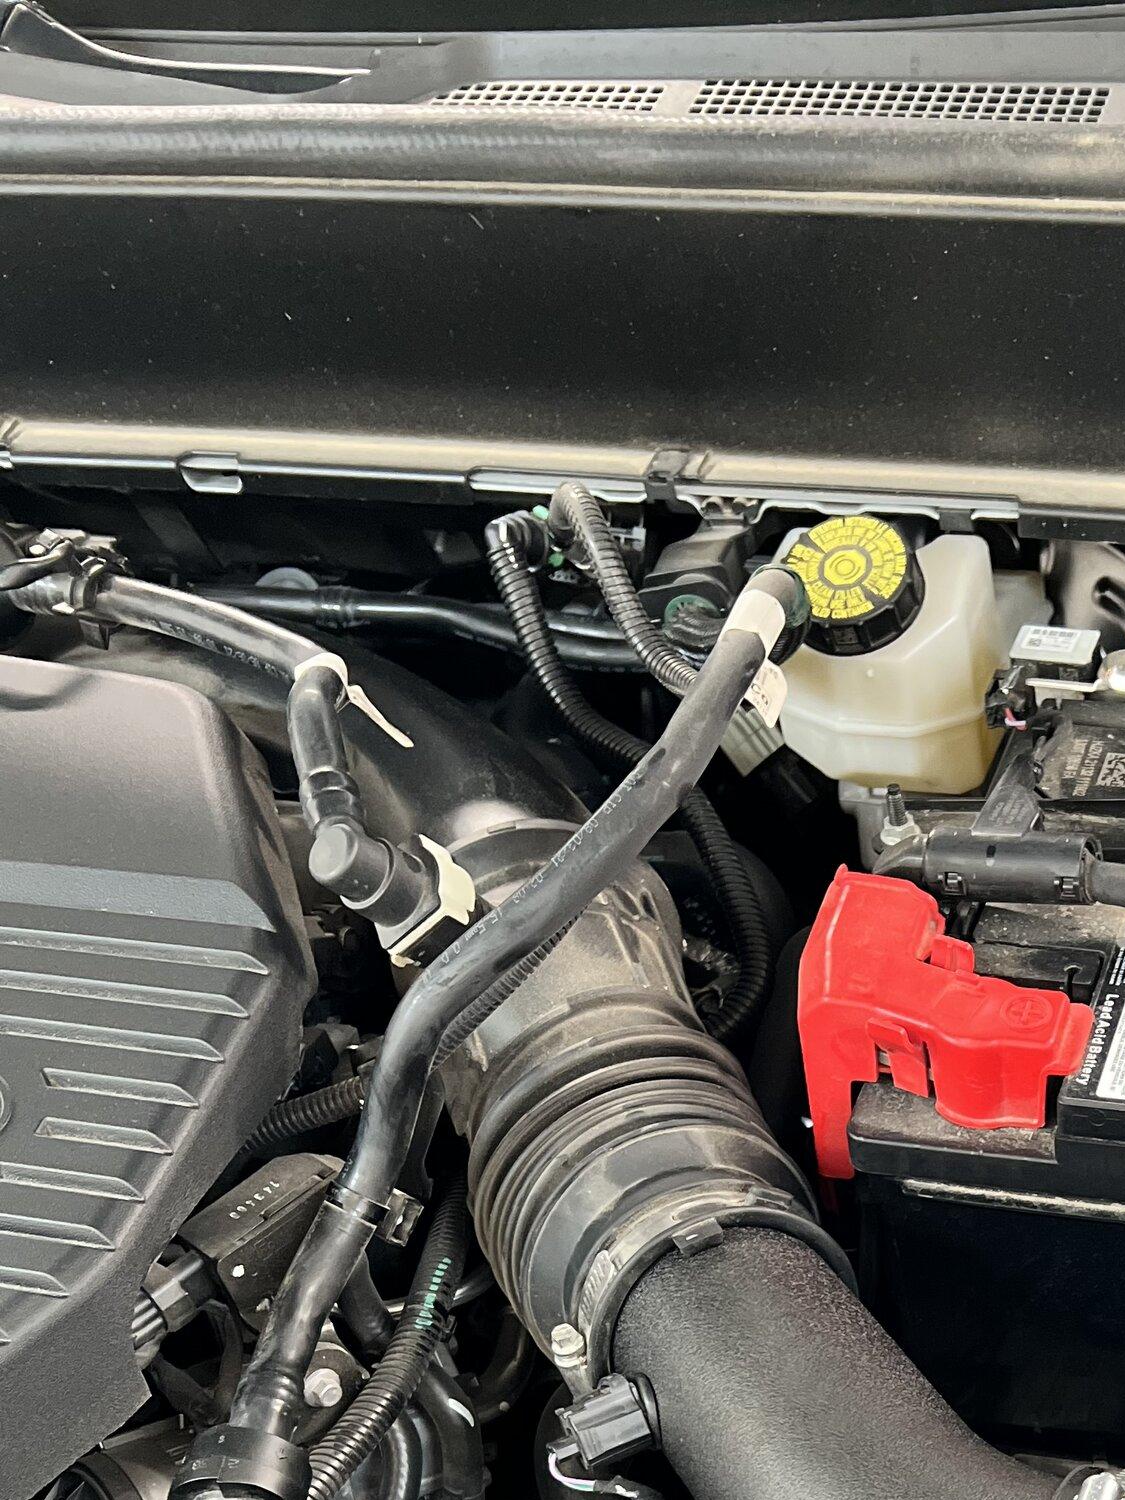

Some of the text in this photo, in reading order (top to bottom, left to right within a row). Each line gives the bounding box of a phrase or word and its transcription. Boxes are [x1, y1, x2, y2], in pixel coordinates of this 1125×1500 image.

[1075, 993, 1120, 1085] Lead Acid Battery
